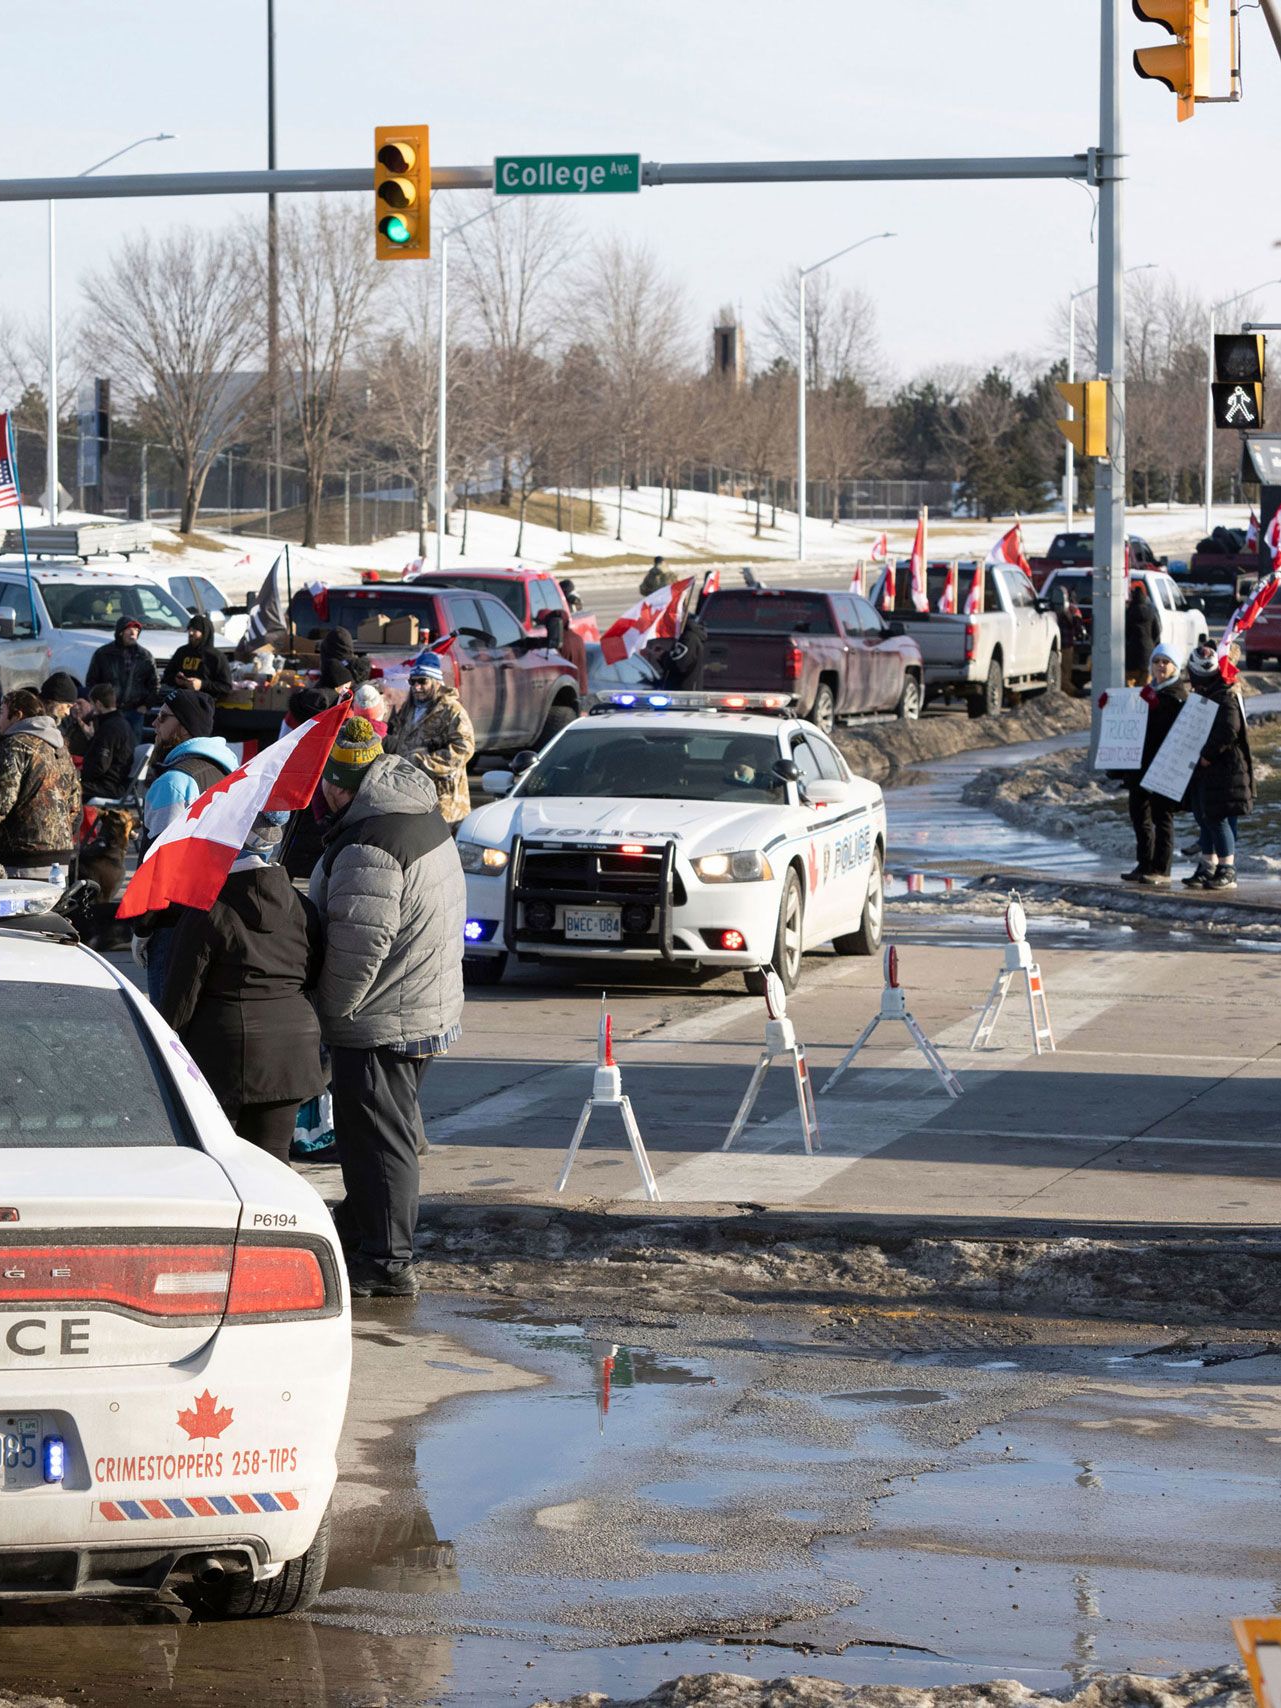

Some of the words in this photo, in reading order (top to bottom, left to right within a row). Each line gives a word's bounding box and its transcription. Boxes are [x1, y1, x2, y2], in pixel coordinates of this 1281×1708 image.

[502, 162, 606, 192] College
[610, 162, 632, 175] Ave.
[182, 656, 202, 670] CAT
[567, 917, 593, 932] BWEC
[253, 1214, 297, 1226] P6194
[95, 1452, 223, 1483] CRIMESTOPPERS
[232, 1447, 298, 1476] 258-TIPS
